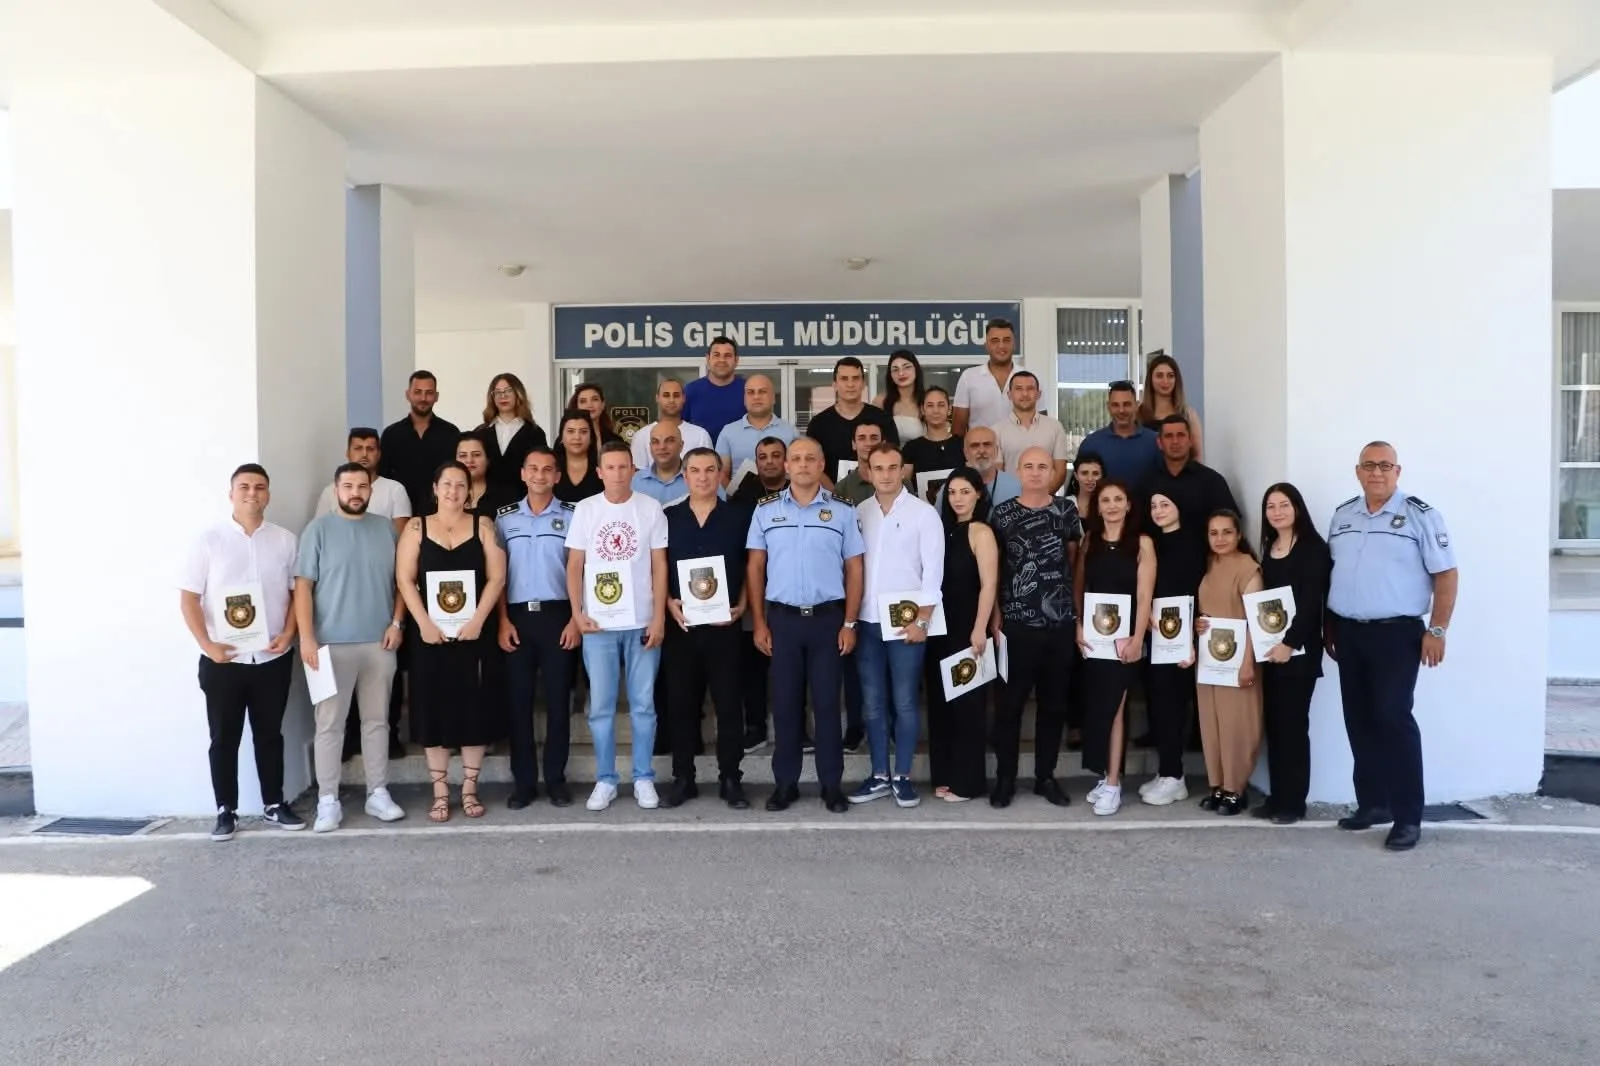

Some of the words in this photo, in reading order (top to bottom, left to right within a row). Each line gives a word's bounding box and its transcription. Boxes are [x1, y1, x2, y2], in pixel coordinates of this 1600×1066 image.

[584, 315, 674, 348] POLİS
[683, 321, 784, 348] GENEL
[793, 313, 989, 346] MÜDÜRLÜĞÜ
